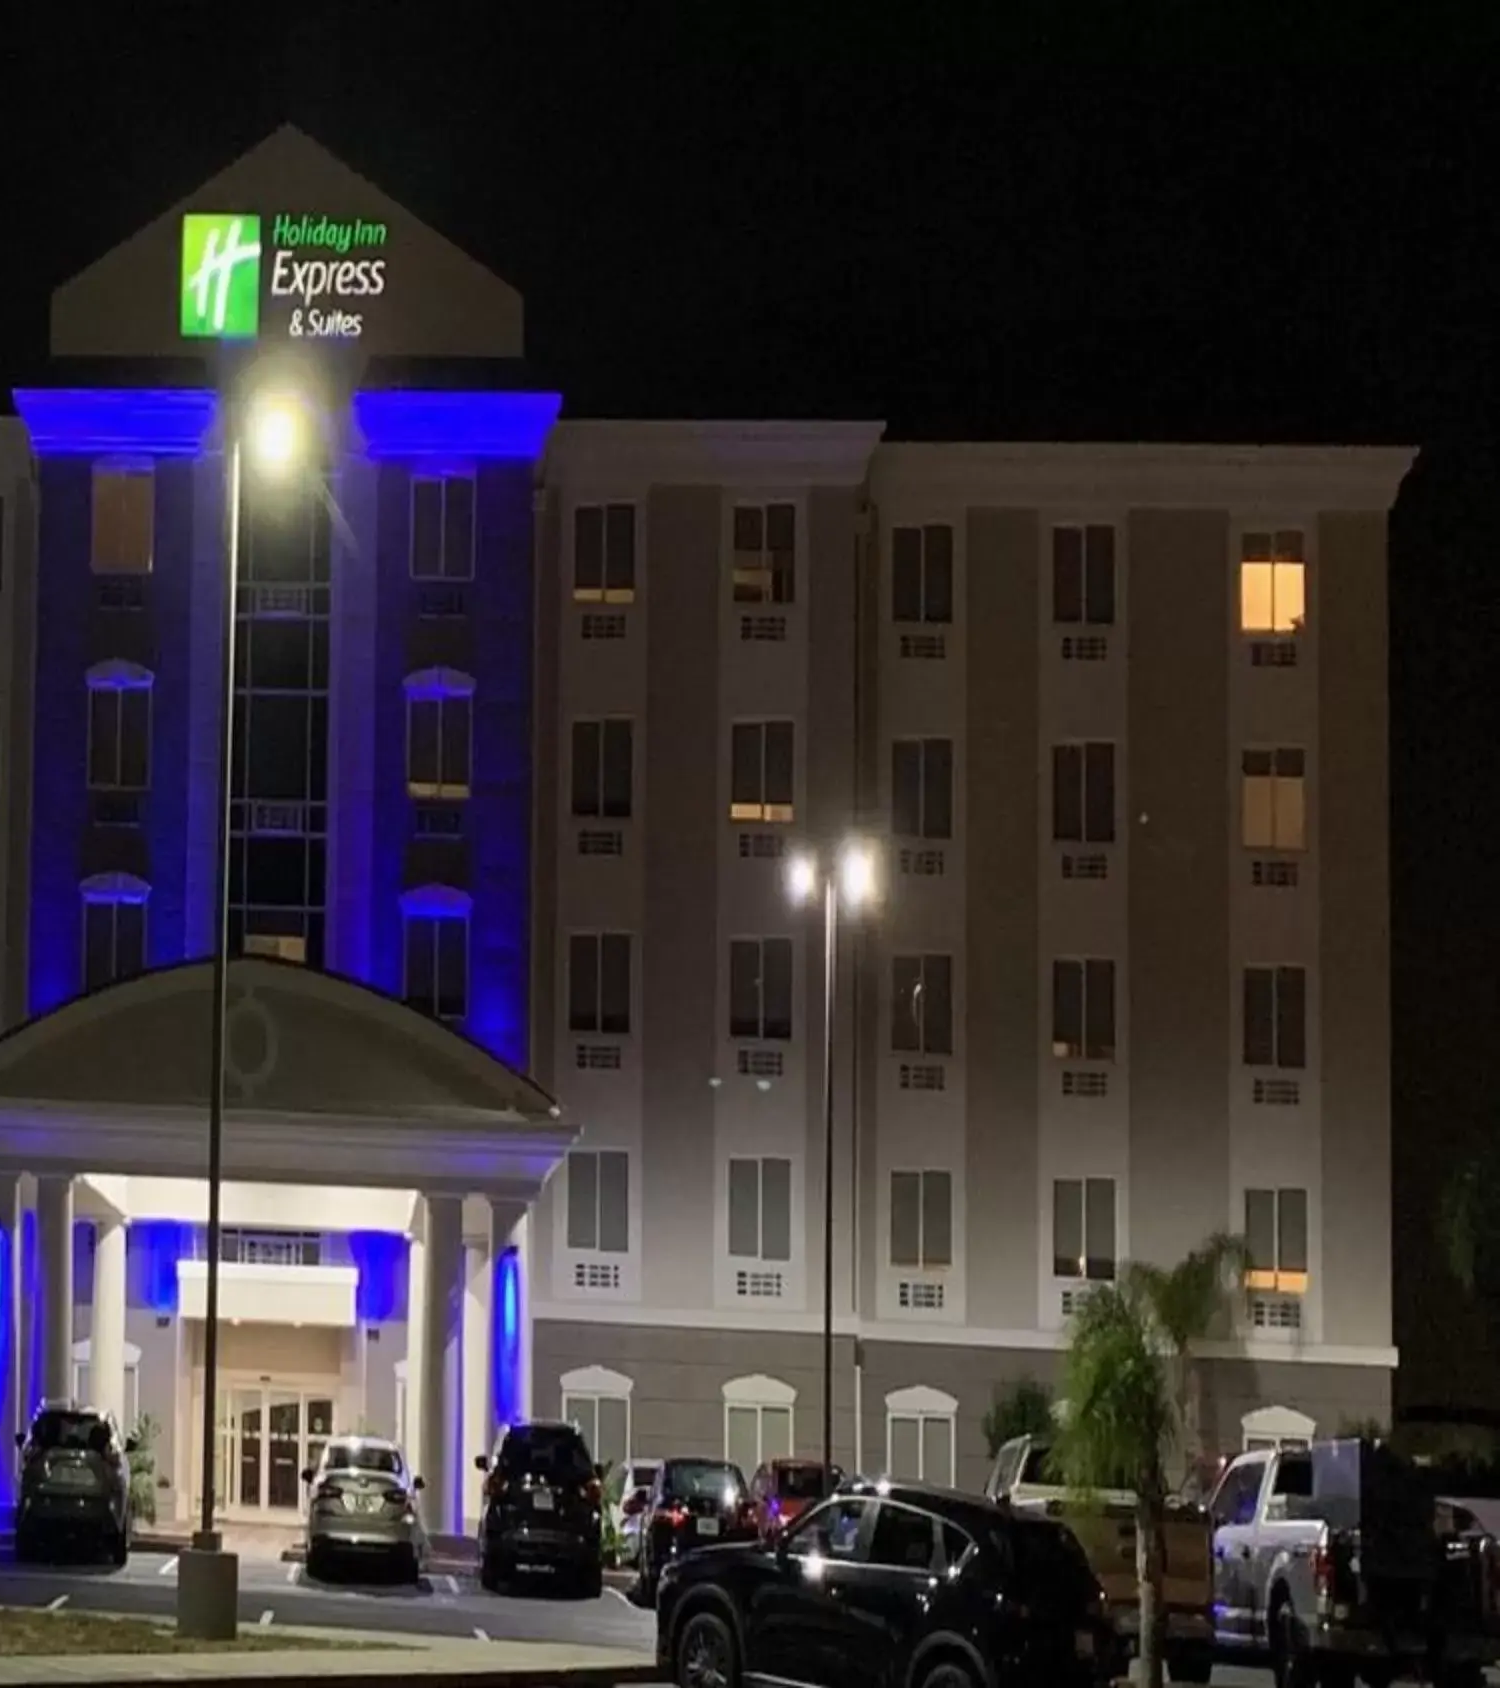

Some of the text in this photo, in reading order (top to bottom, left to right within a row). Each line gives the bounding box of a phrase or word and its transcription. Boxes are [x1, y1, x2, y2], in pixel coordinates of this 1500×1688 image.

[274, 214, 387, 252] Holiday Inn
[271, 250, 385, 305] Express
[289, 309, 362, 337] & Suites
